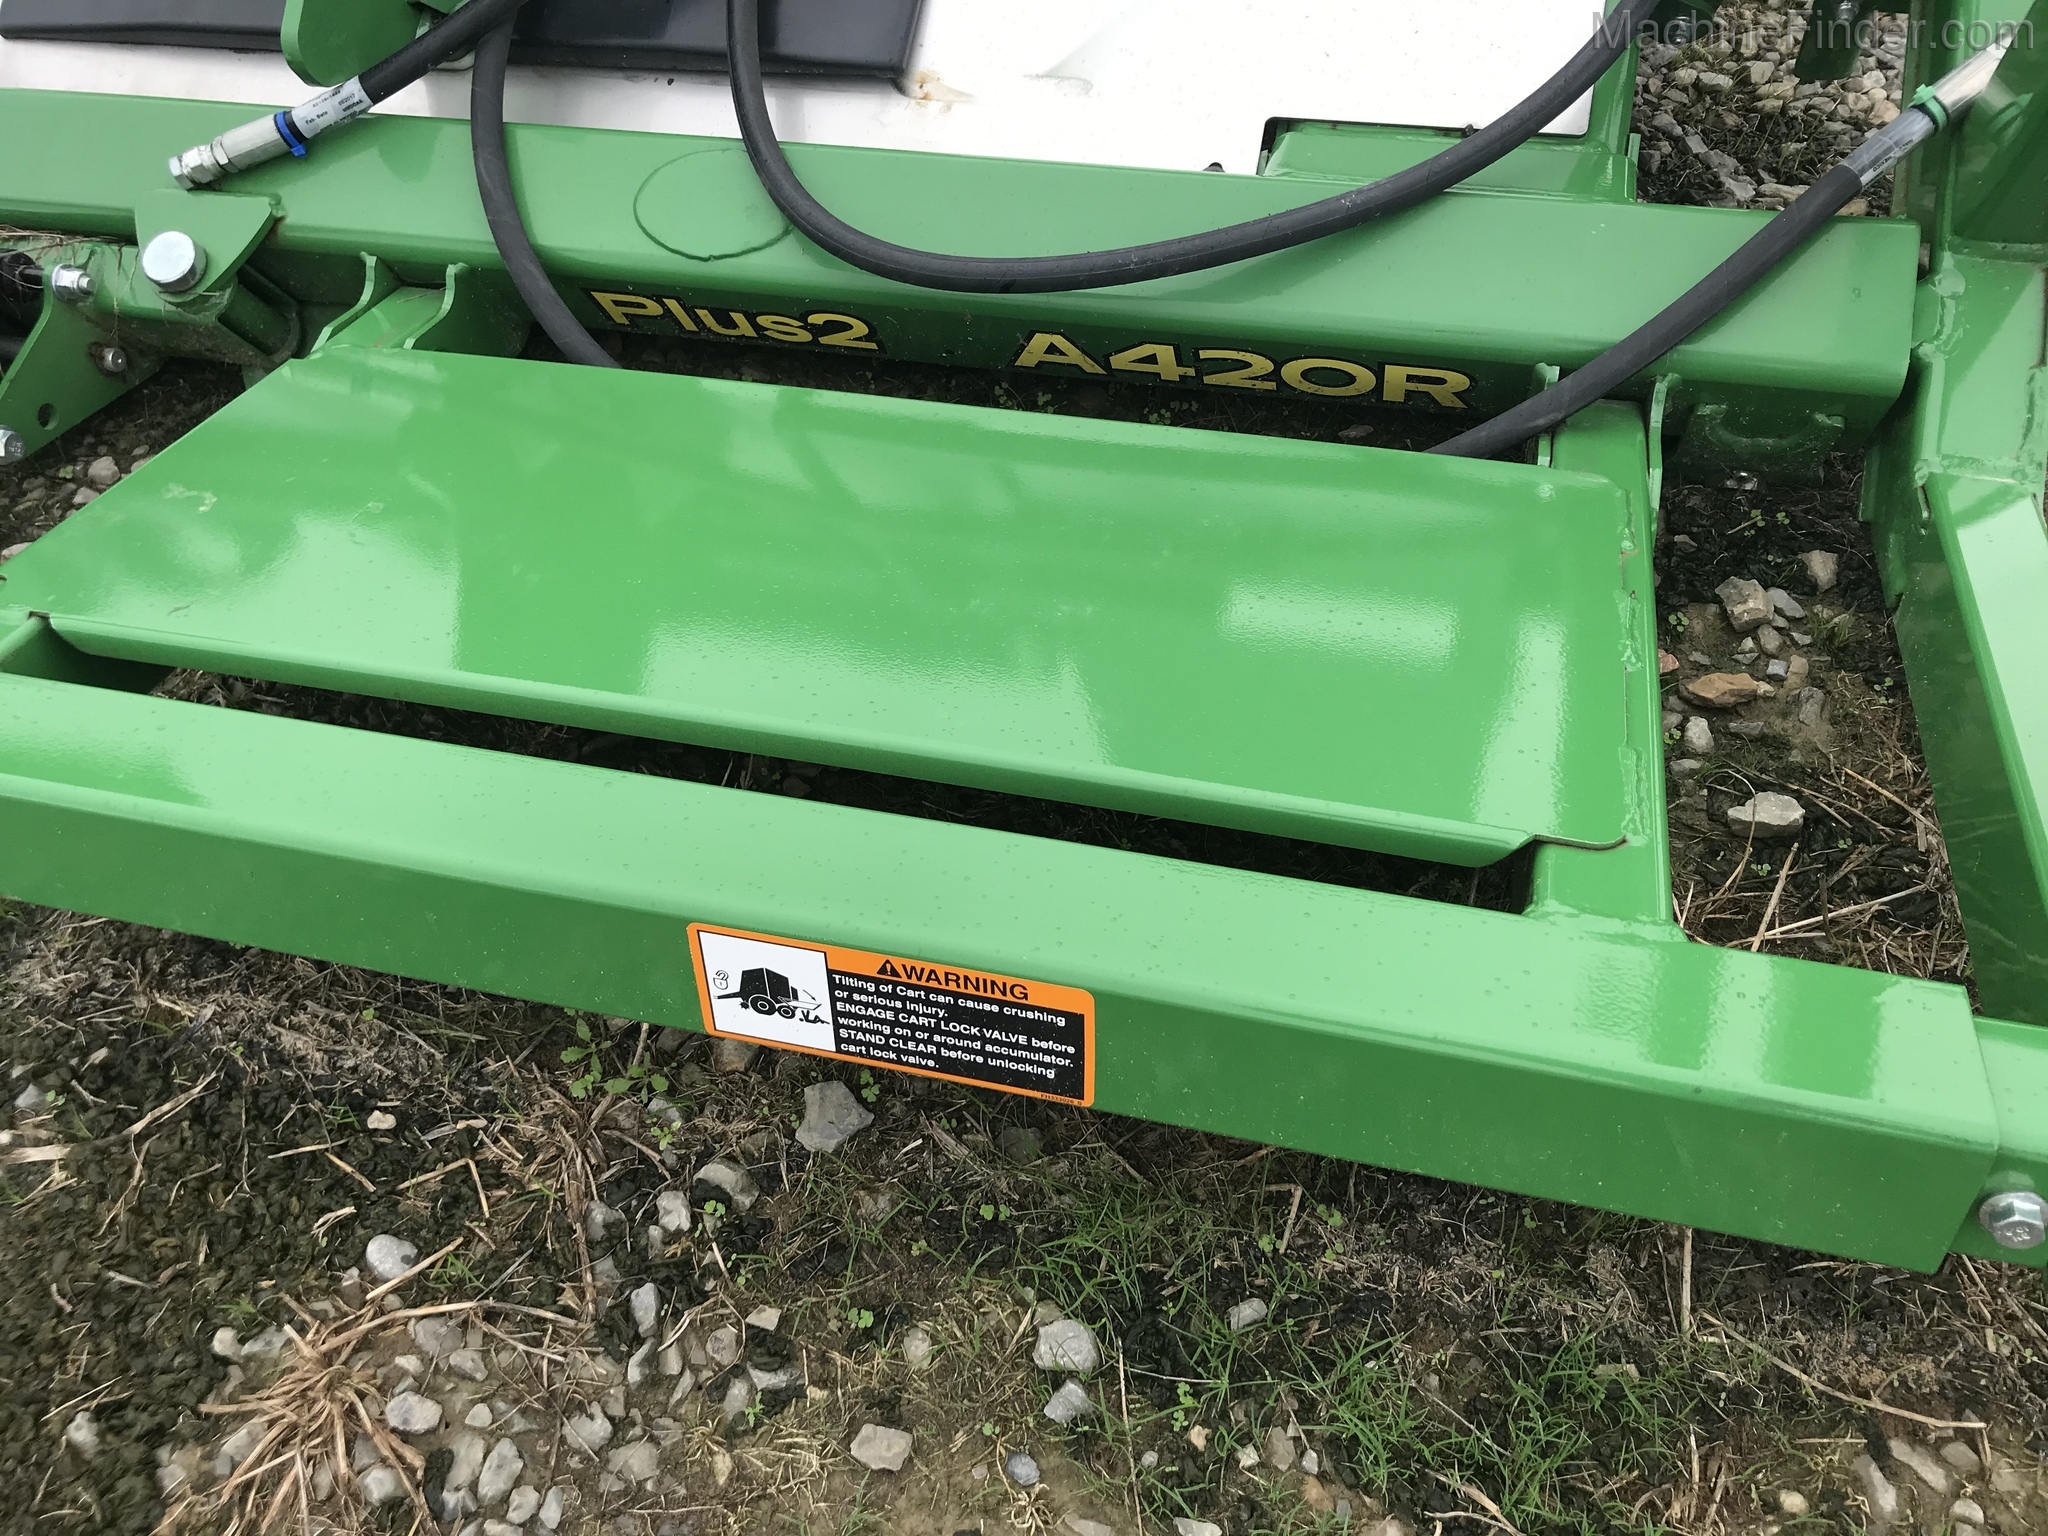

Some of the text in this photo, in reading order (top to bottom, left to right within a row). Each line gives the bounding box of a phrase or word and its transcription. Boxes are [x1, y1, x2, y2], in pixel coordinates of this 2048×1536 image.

[590, 291, 1471, 409] Plus2 A420R
[832, 974, 1066, 1027] Tilting of Cart can cause crushing
[834, 989, 948, 1018] or serious injury.
[901, 963, 1028, 1001] WARNING
[836, 1001, 1075, 1054] ENGAGE CART LOCK VALVE before
[837, 1016, 1074, 1067] working on or around accumulator.
[839, 1028, 1055, 1079] STAND CLEAR before unlocking
[840, 1043, 940, 1068] cart lock valve.
